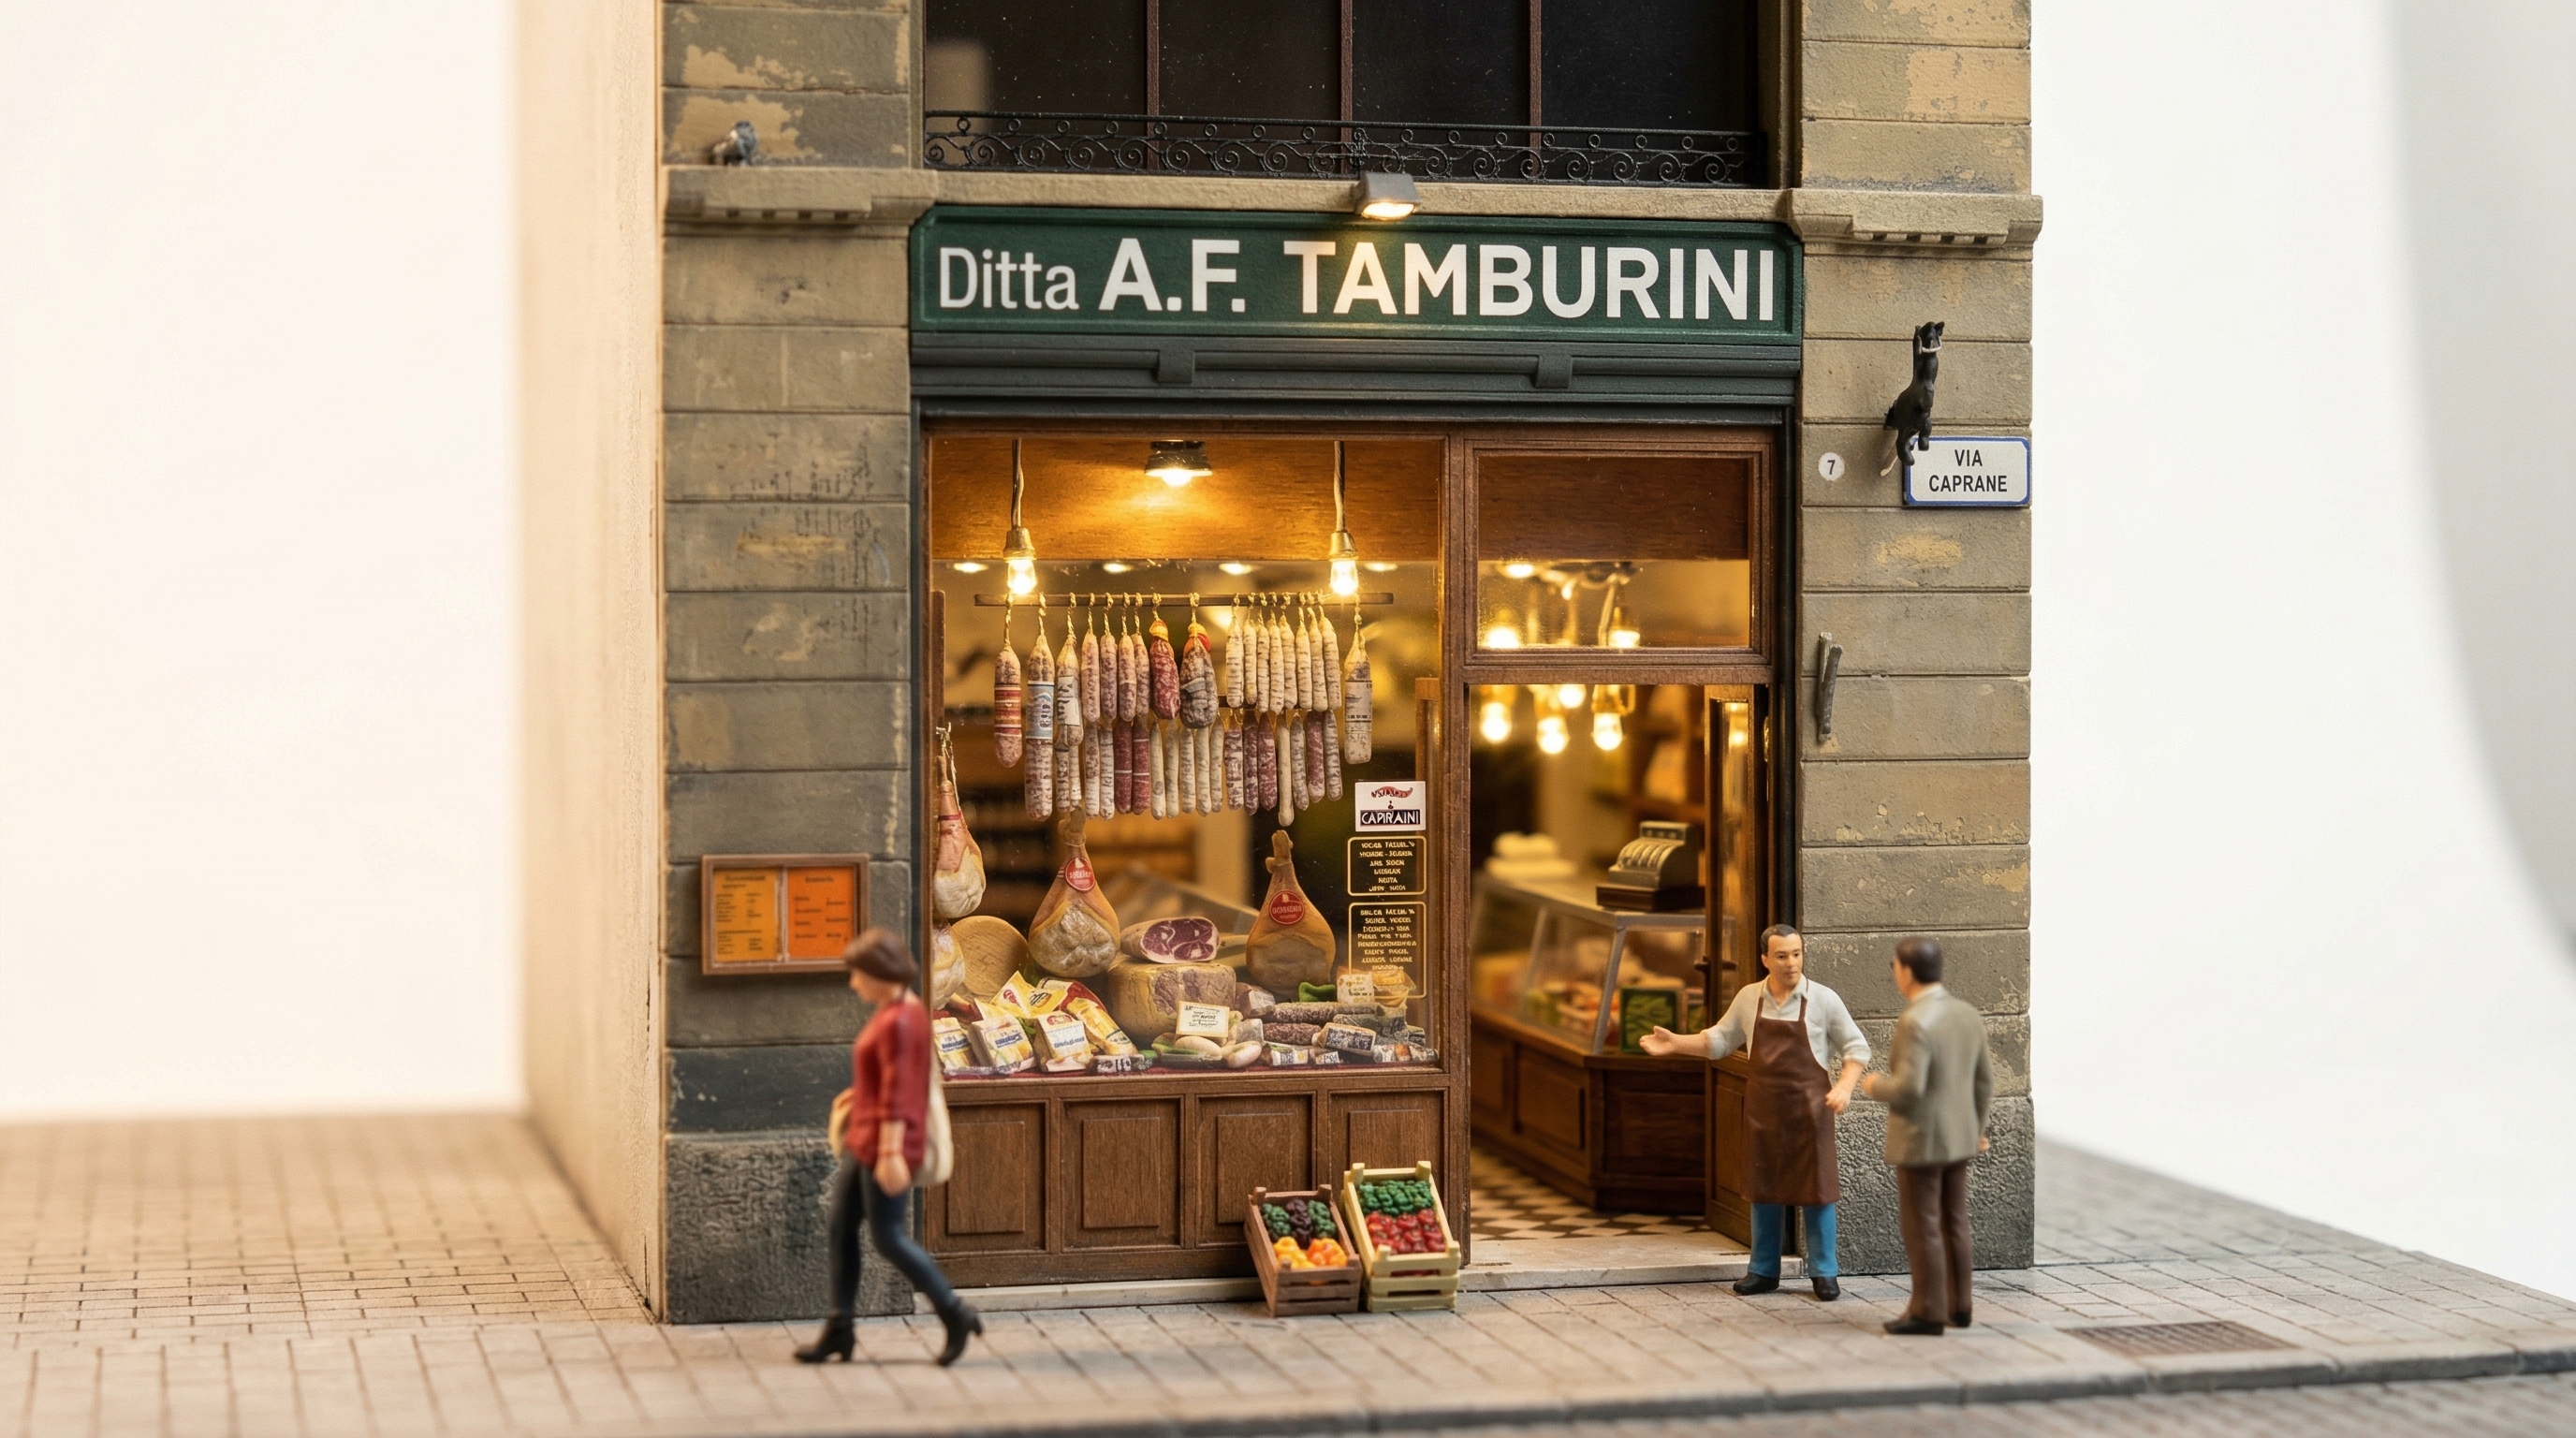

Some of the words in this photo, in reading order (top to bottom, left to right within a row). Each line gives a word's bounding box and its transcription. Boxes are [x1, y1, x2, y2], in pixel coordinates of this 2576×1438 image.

[940, 246, 1080, 310] Ditta
[1098, 238, 1247, 314] A.F.
[1283, 240, 1775, 321] TAMBURINI
[1954, 449, 1983, 467] VIA
[1827, 459, 1837, 476] 7
[1928, 475, 2008, 492] CAPRANE
